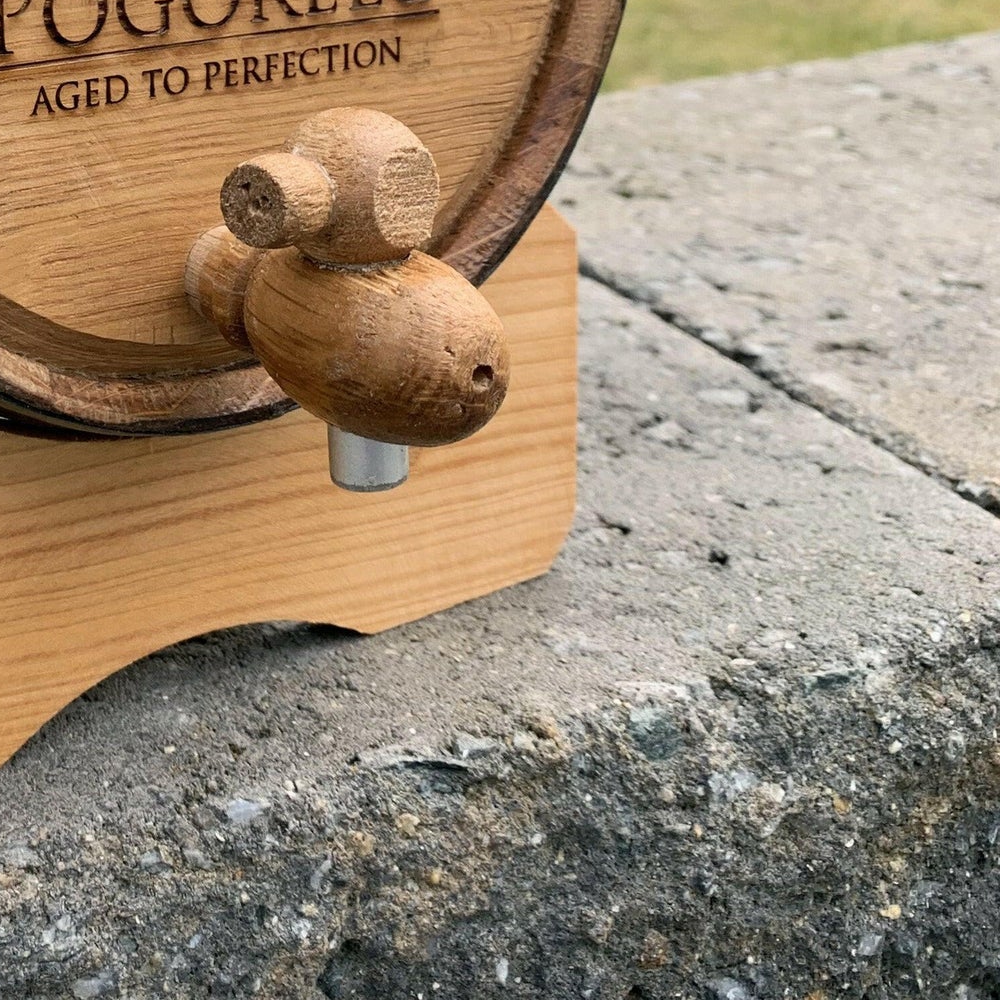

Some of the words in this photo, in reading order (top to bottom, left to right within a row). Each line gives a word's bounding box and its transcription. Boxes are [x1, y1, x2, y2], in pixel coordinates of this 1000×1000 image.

[30, 75, 130, 117] AGED
[142, 66, 190, 99] TO
[204, 36, 401, 90] PERFECTION
